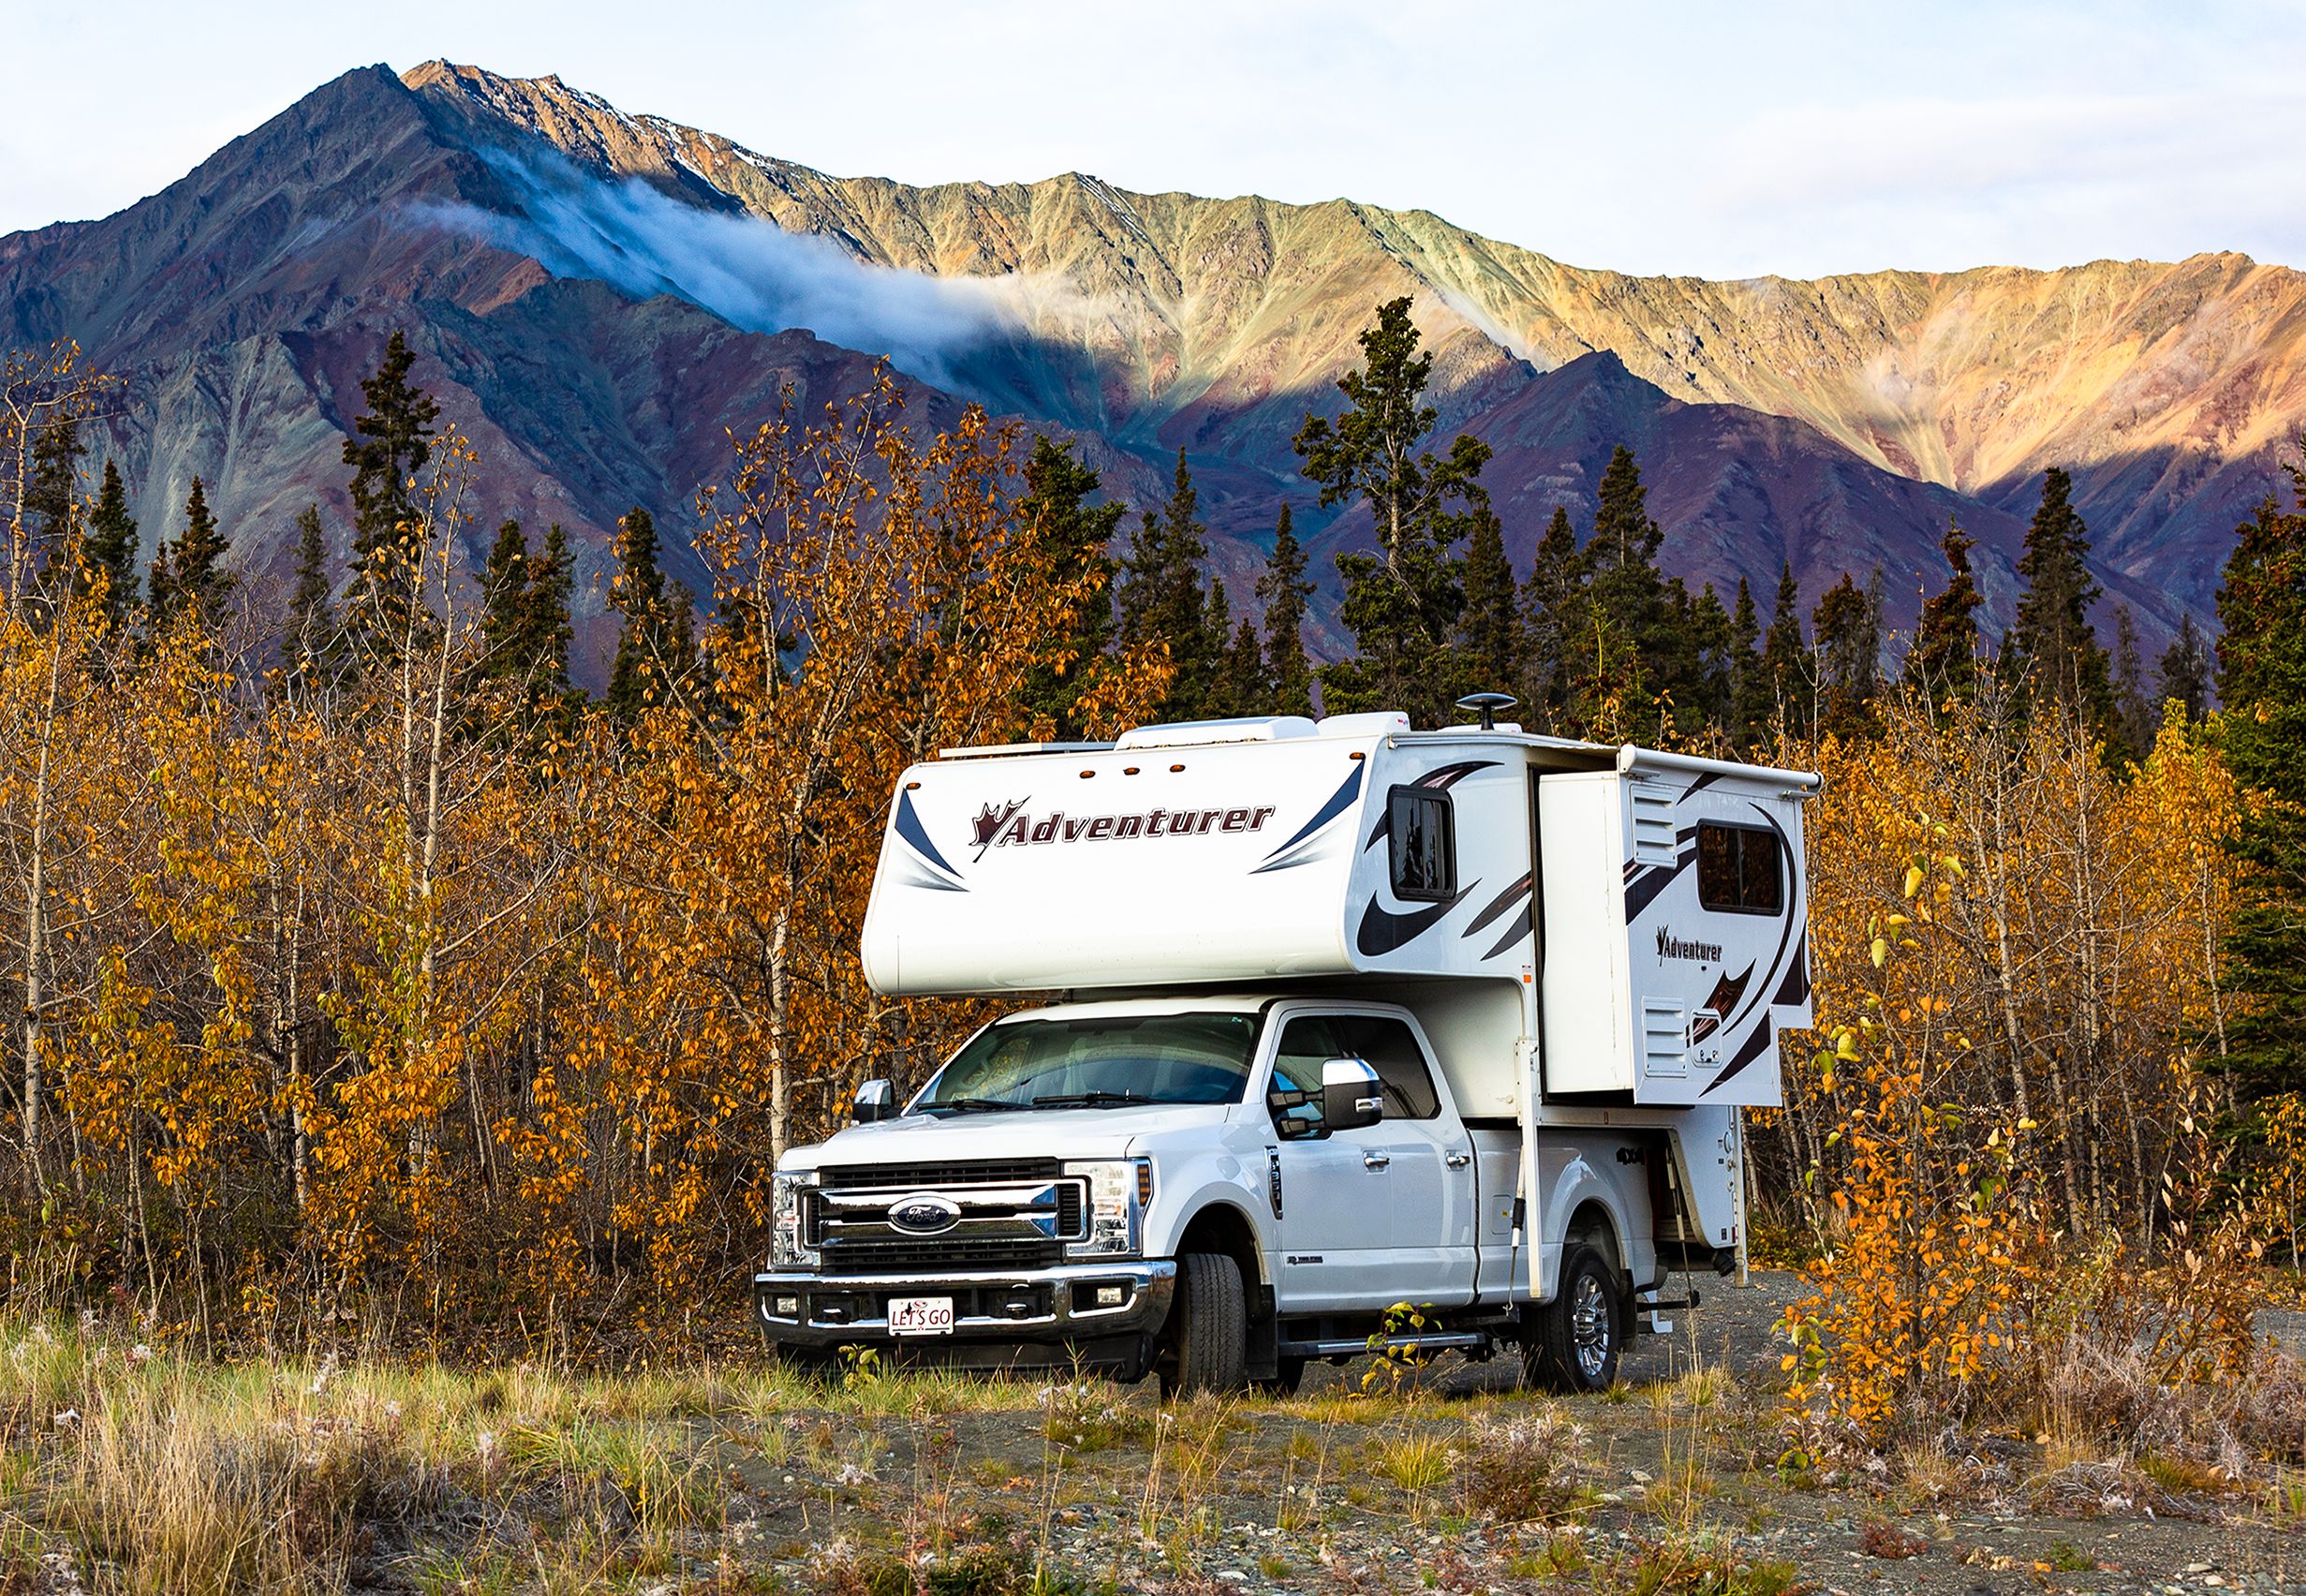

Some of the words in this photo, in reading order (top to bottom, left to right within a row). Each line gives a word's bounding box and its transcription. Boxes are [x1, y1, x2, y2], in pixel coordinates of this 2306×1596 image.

[995, 805, 1276, 847] Adventurer
[1663, 936, 1722, 962] Adventurer
[906, 1205, 940, 1221] Ford
[892, 1309, 925, 1326] LET'S
[929, 1308, 951, 1325] GO
